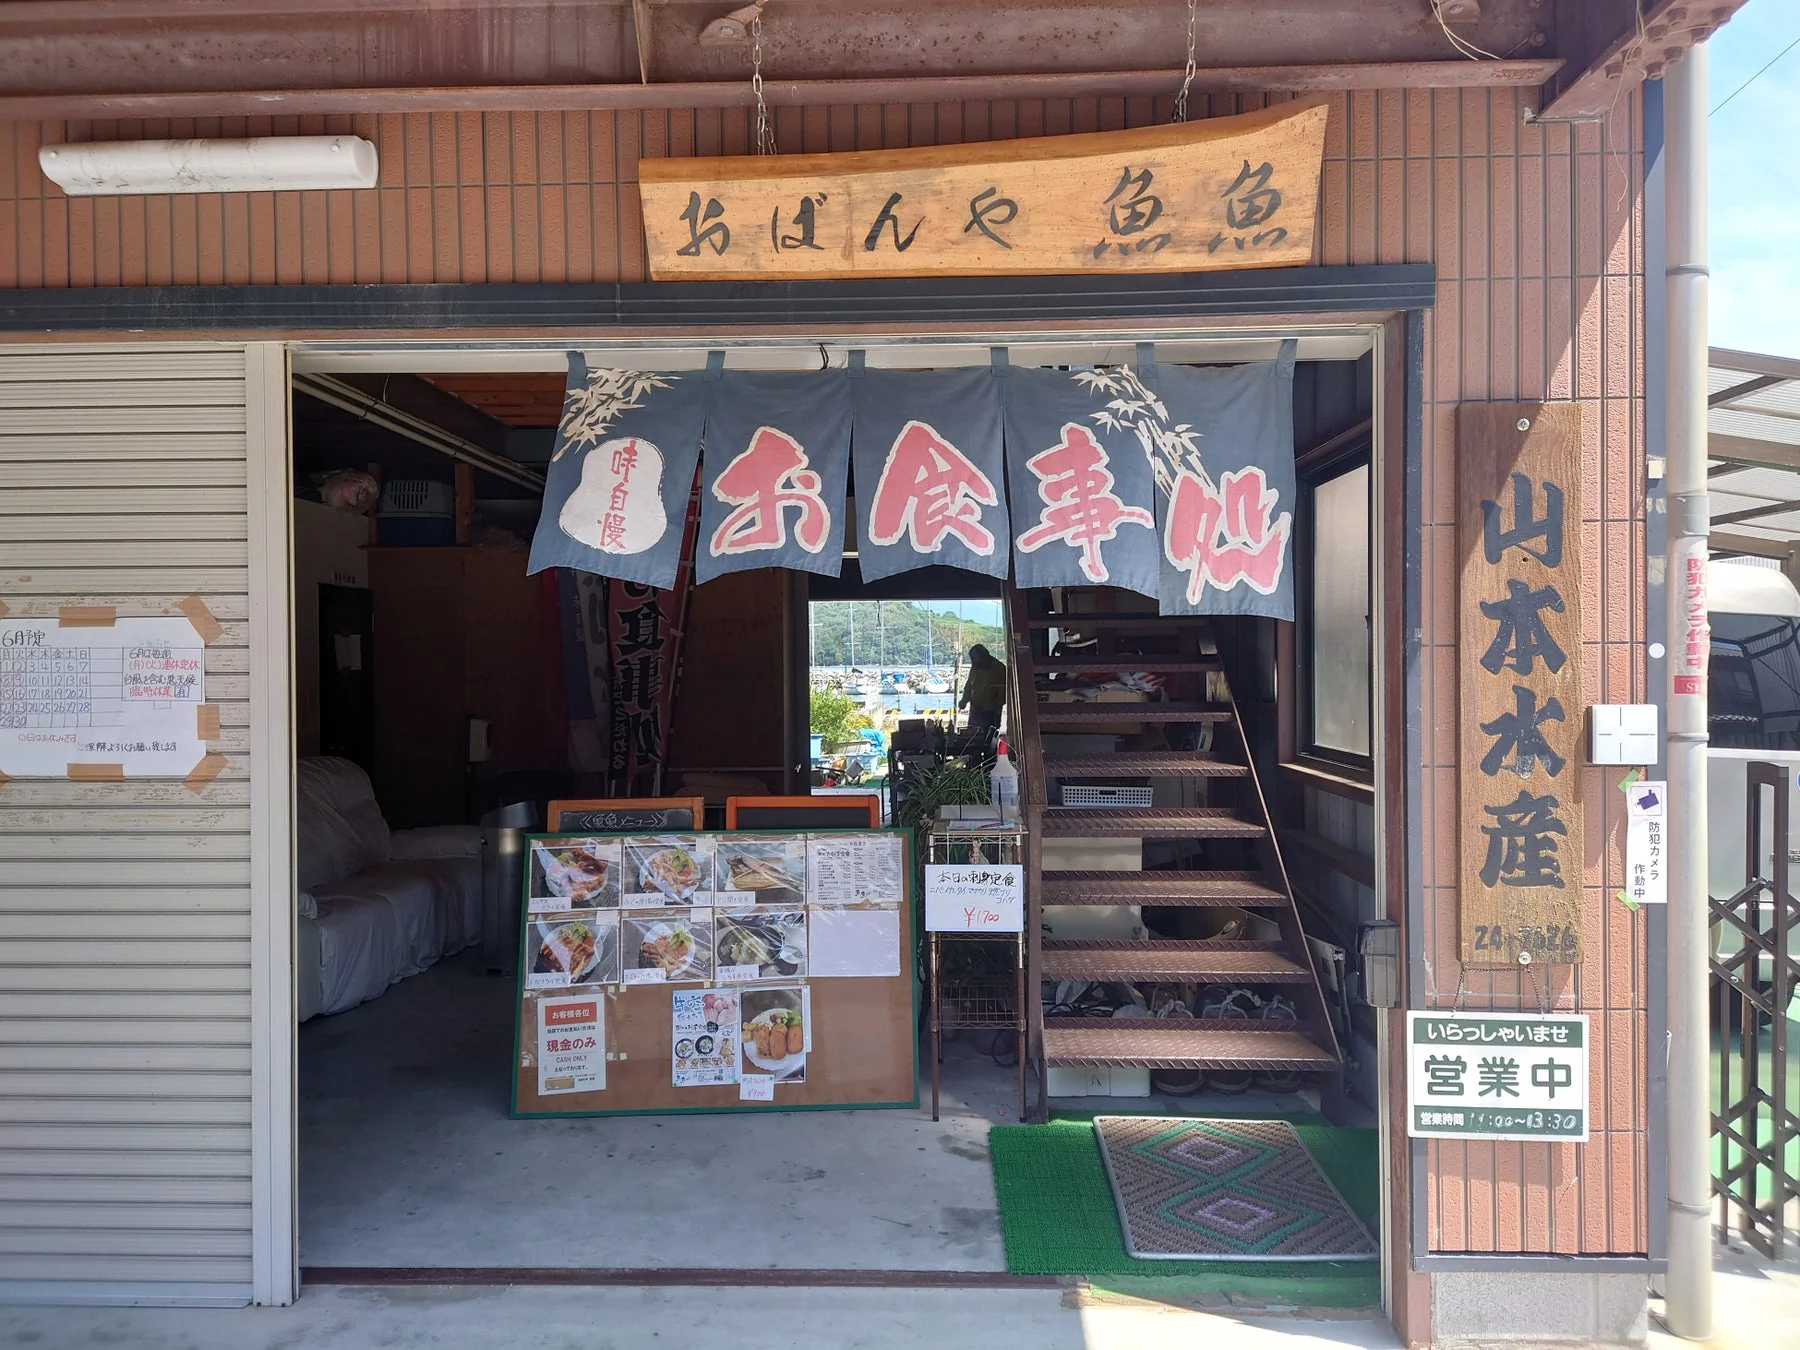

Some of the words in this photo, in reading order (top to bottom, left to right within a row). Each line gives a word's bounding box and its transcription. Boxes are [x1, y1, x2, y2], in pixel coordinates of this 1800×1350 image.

[677, 186, 1018, 257] おばんや
[1093, 159, 1288, 255] 魚魚
[597, 439, 639, 550] 味自慢
[709, 420, 1292, 606] お食事処
[2, 629, 47, 647] 6月予定
[1479, 471, 1568, 889] 山本水産
[1648, 821, 1661, 881] 防犯カメラ
[1633, 863, 1646, 899] 作動中
[552, 1009, 590, 1020] お客様各位
[1427, 1023, 1569, 1043] いらっしゃいませ
[546, 1036, 596, 1053] 現金のみ
[1424, 1054, 1572, 1099] 営業中
[1420, 1112, 1465, 1126] 営業時間
